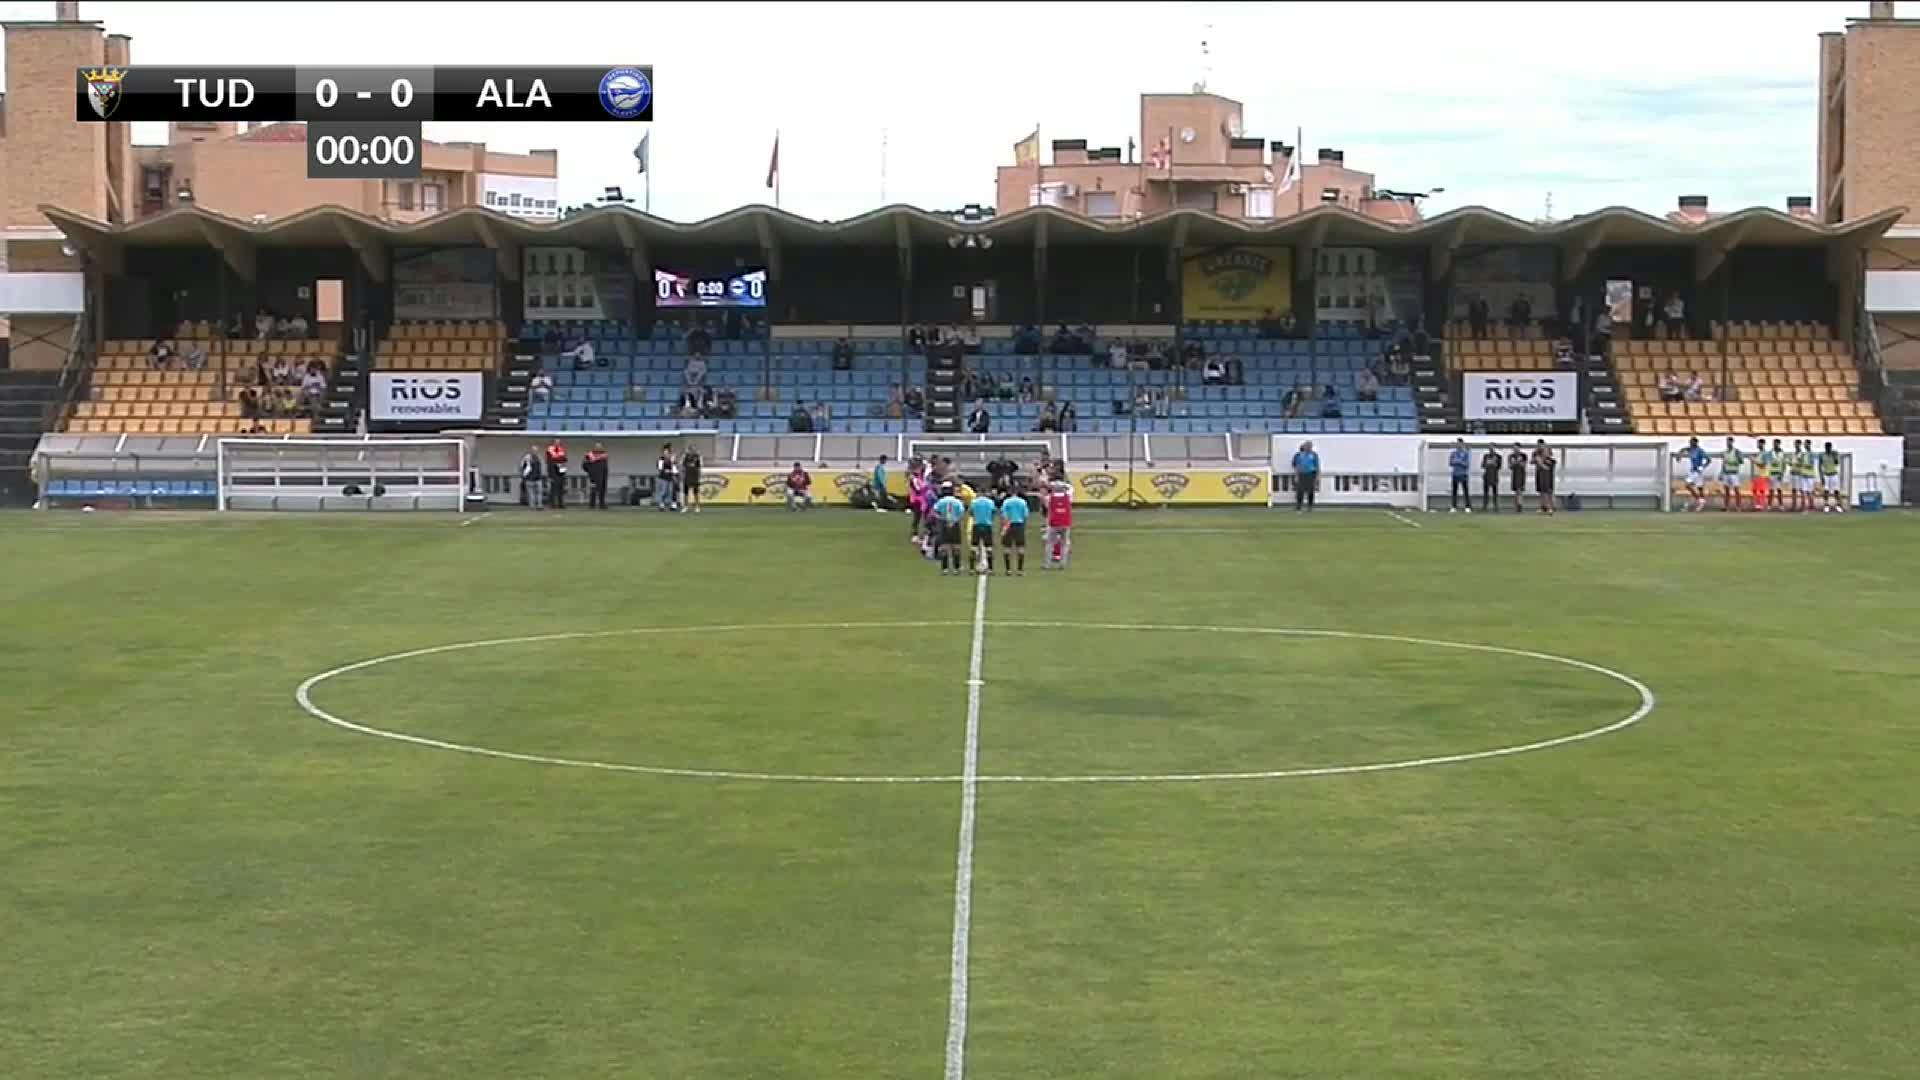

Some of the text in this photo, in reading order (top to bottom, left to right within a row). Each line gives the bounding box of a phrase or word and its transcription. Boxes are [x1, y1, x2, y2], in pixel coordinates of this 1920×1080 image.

[658, 279, 671, 299] 0
[751, 279, 763, 299] 0
[391, 402, 462, 414] renovables
[1484, 403, 1555, 414] renovables
